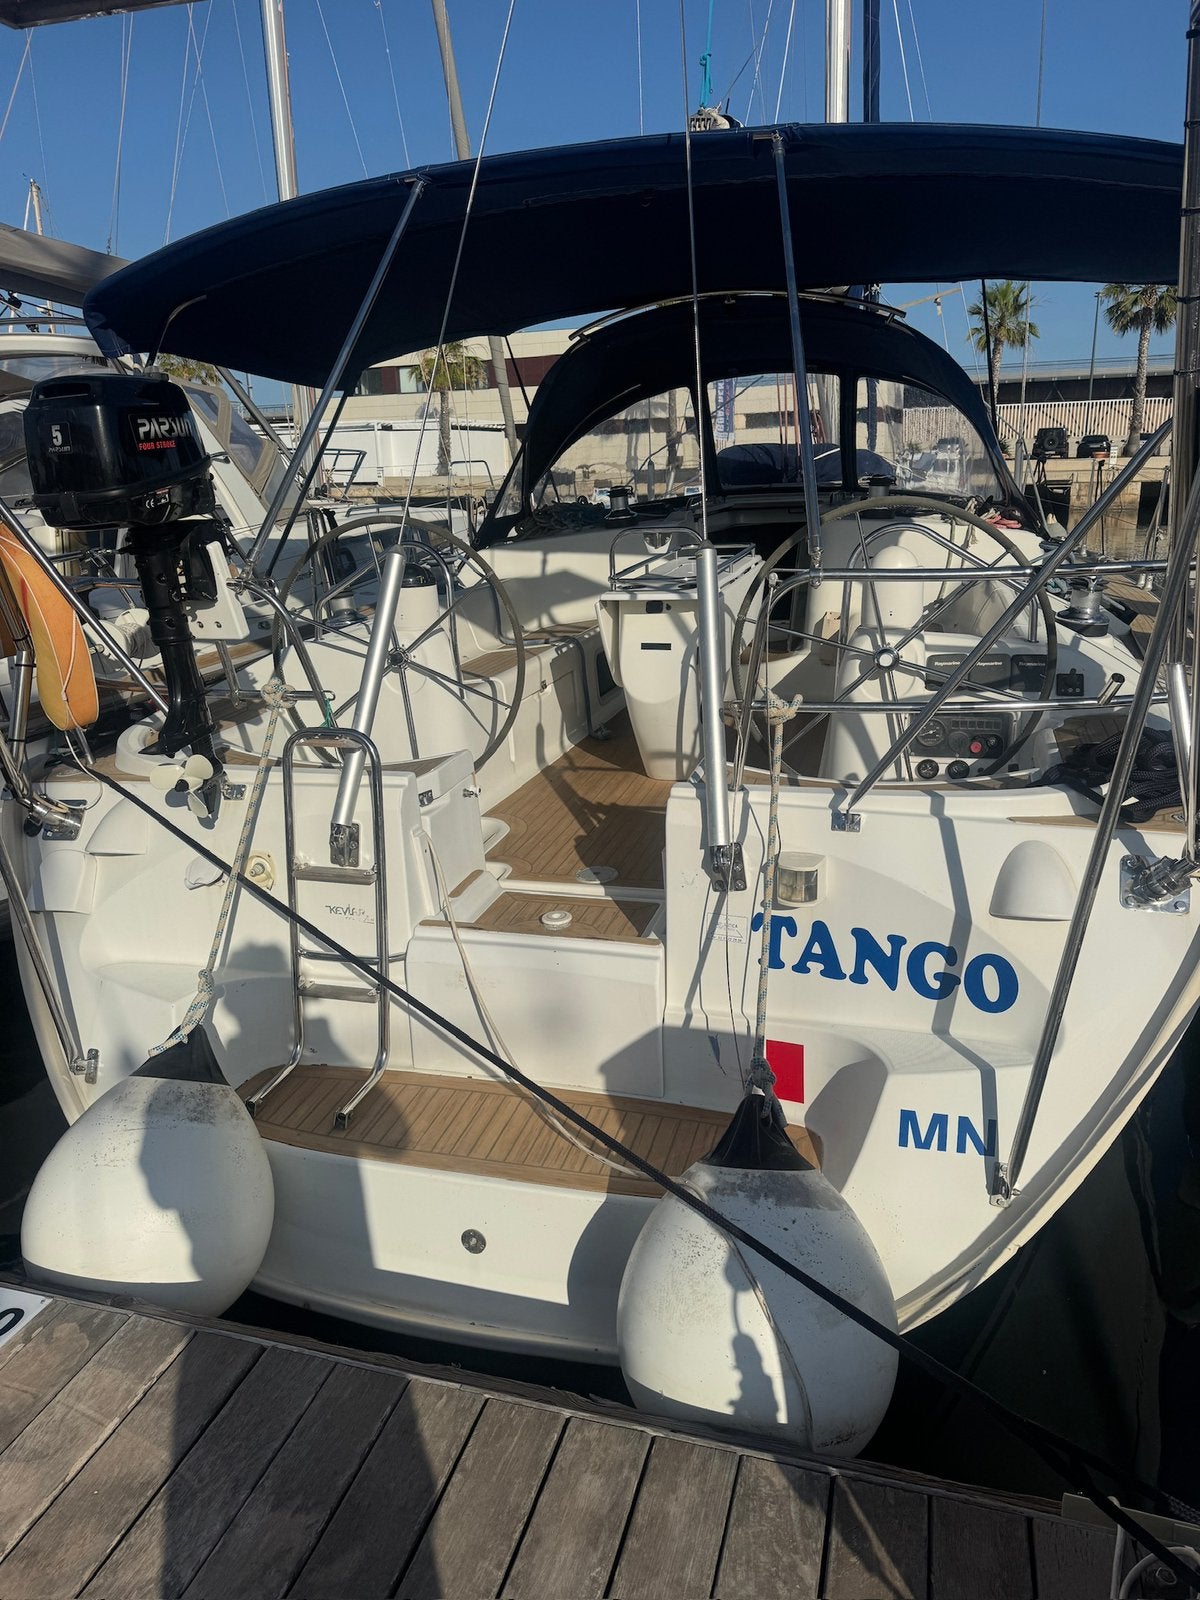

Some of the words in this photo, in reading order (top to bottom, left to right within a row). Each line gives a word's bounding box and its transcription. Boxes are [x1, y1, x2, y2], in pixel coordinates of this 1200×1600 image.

[51, 424, 63, 447] 5
[137, 416, 193, 440] PARSUN
[138, 442, 156, 450] FOUR
[156, 440, 177, 449] STROKE
[751, 912, 1019, 1014] TANGO
[898, 1108, 996, 1157] MN
